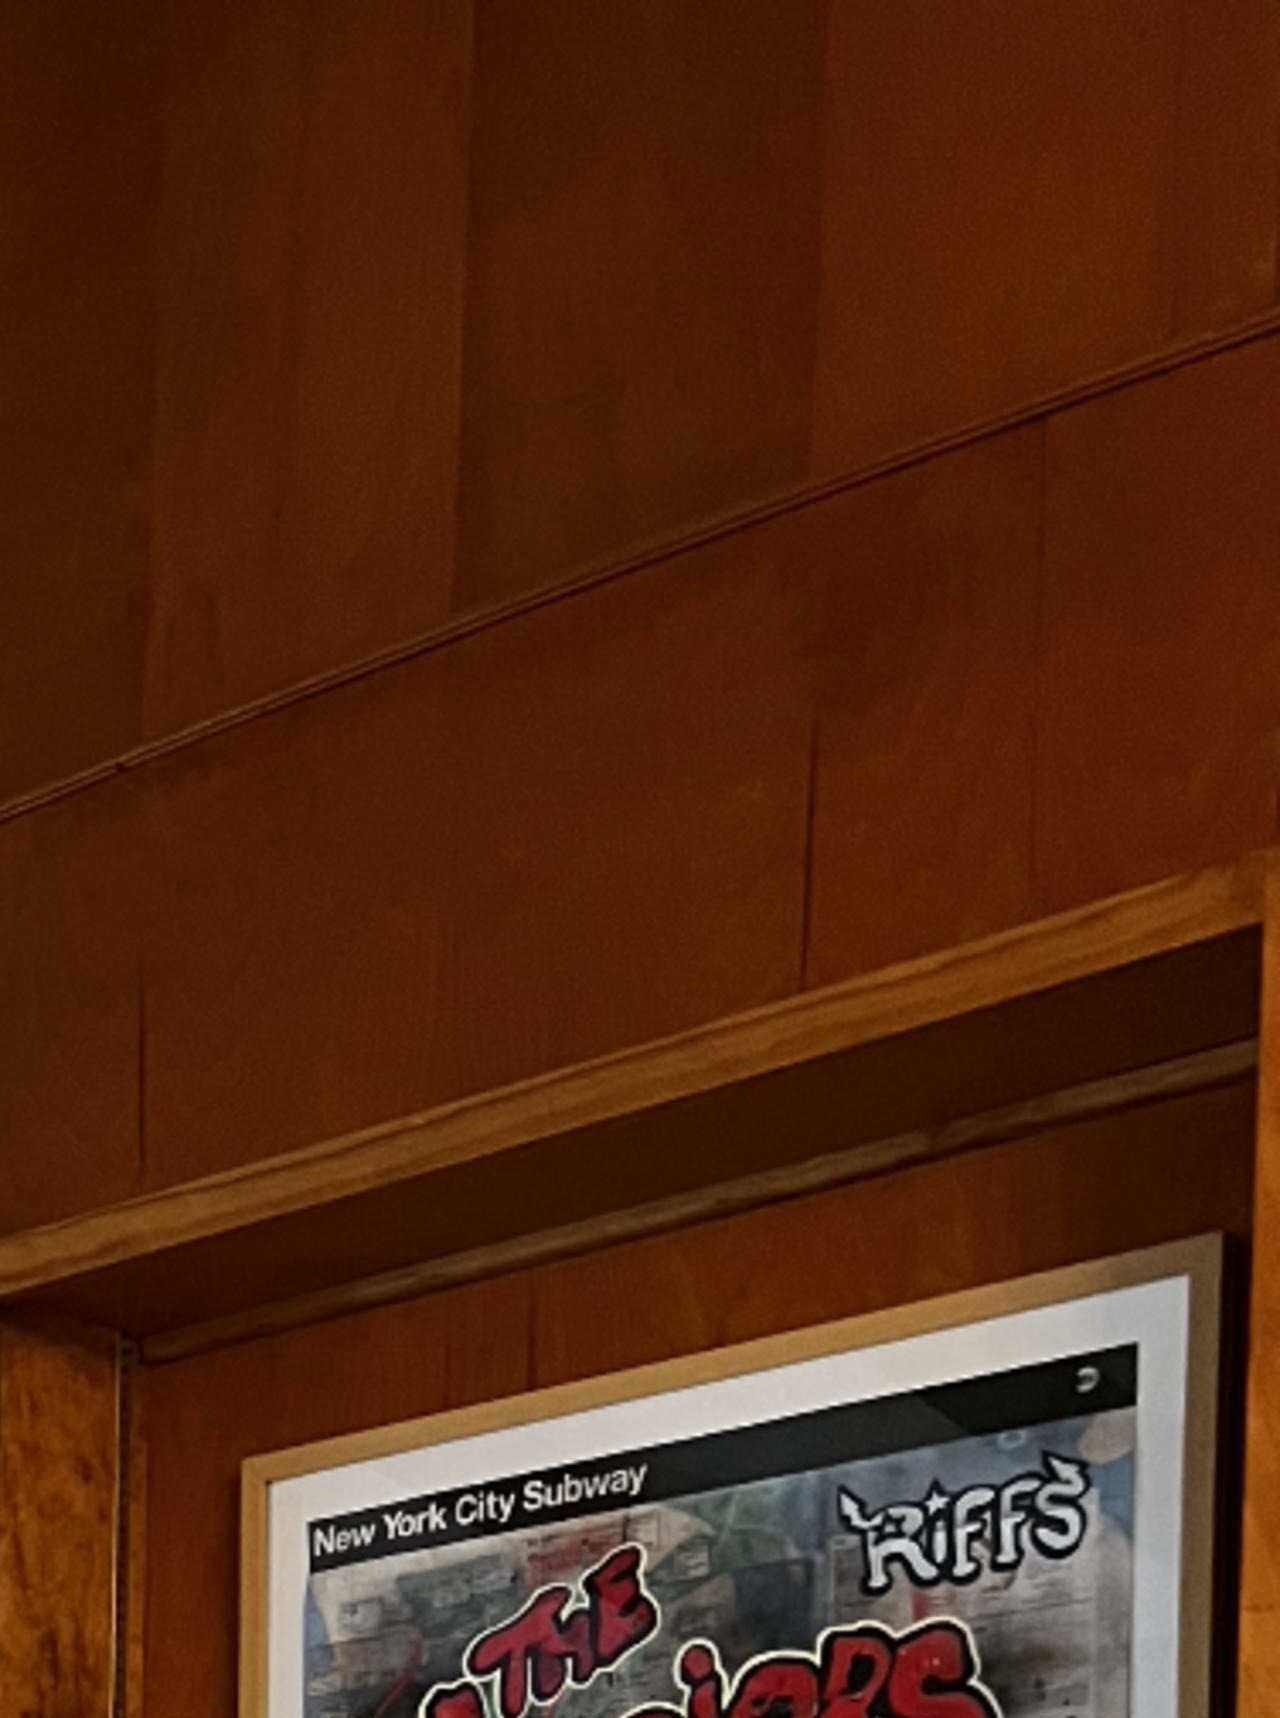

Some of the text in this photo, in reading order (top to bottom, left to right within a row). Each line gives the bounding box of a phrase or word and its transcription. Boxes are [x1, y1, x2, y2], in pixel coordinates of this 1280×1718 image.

[313, 1464, 648, 1556] New York City Subway
